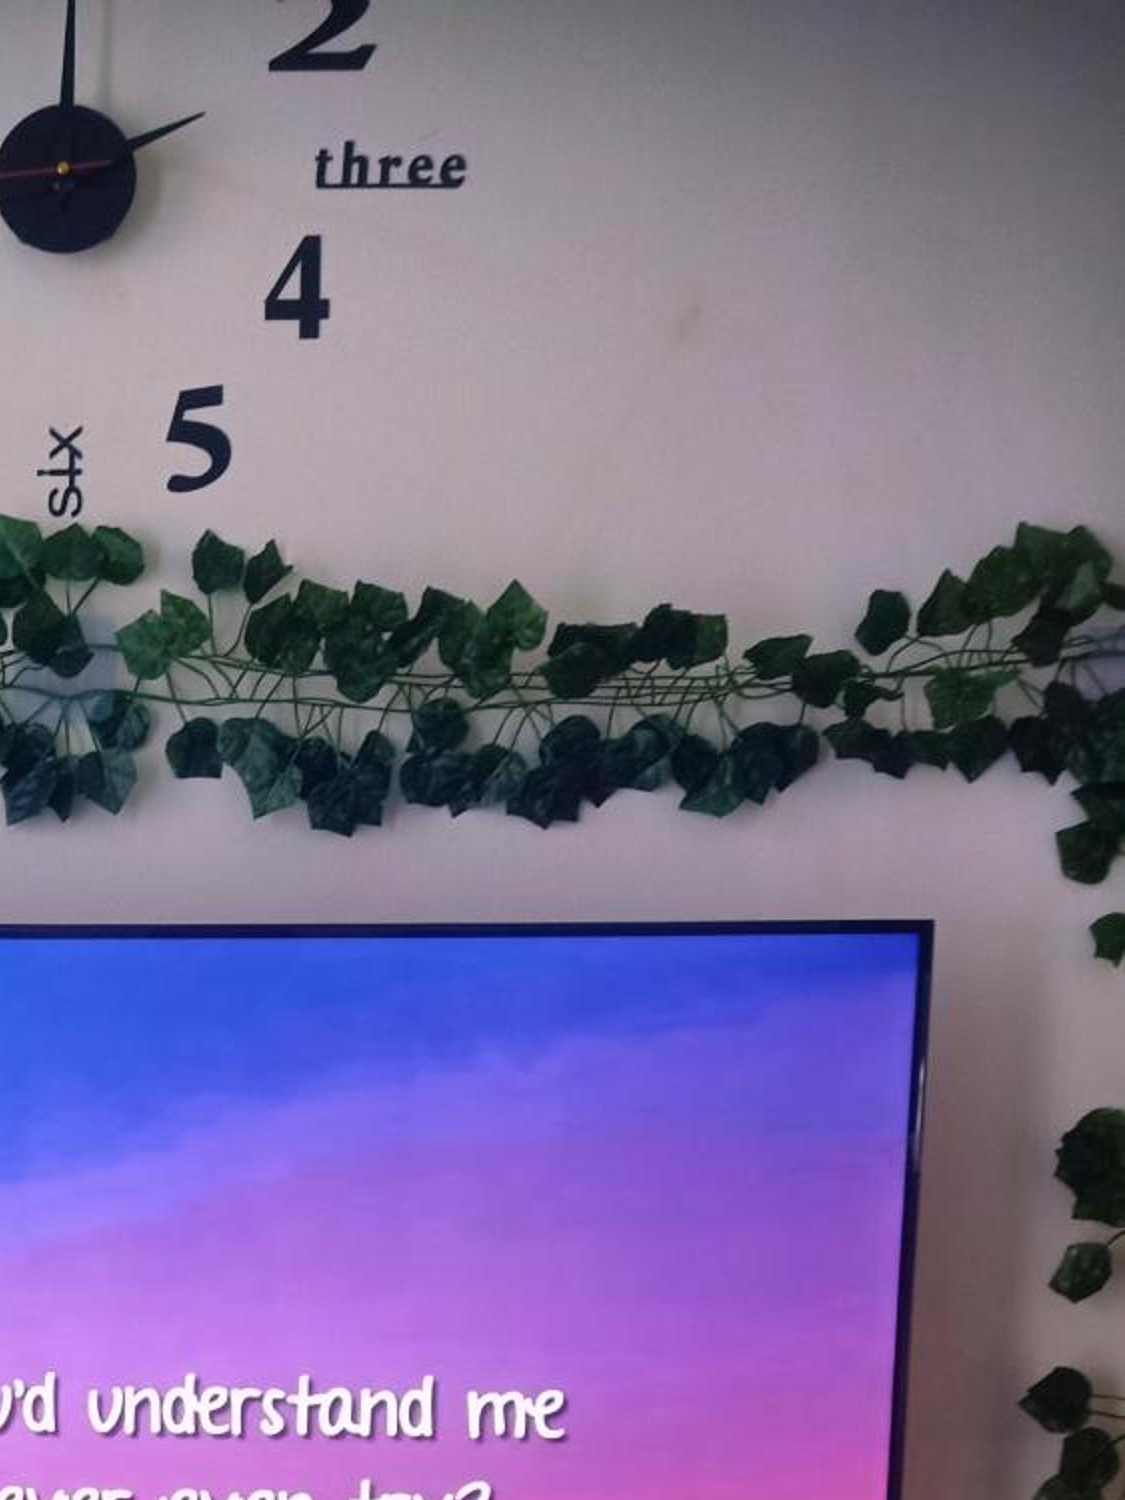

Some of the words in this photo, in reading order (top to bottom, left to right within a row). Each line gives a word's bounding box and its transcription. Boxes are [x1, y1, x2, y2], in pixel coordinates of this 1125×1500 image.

[314, 140, 468, 190] three
[264, 234, 331, 340] 4
[37, 425, 83, 518] six
[165, 384, 232, 494] 5
[88, 1372, 435, 1437] understand
[467, 1389, 565, 1439] me
